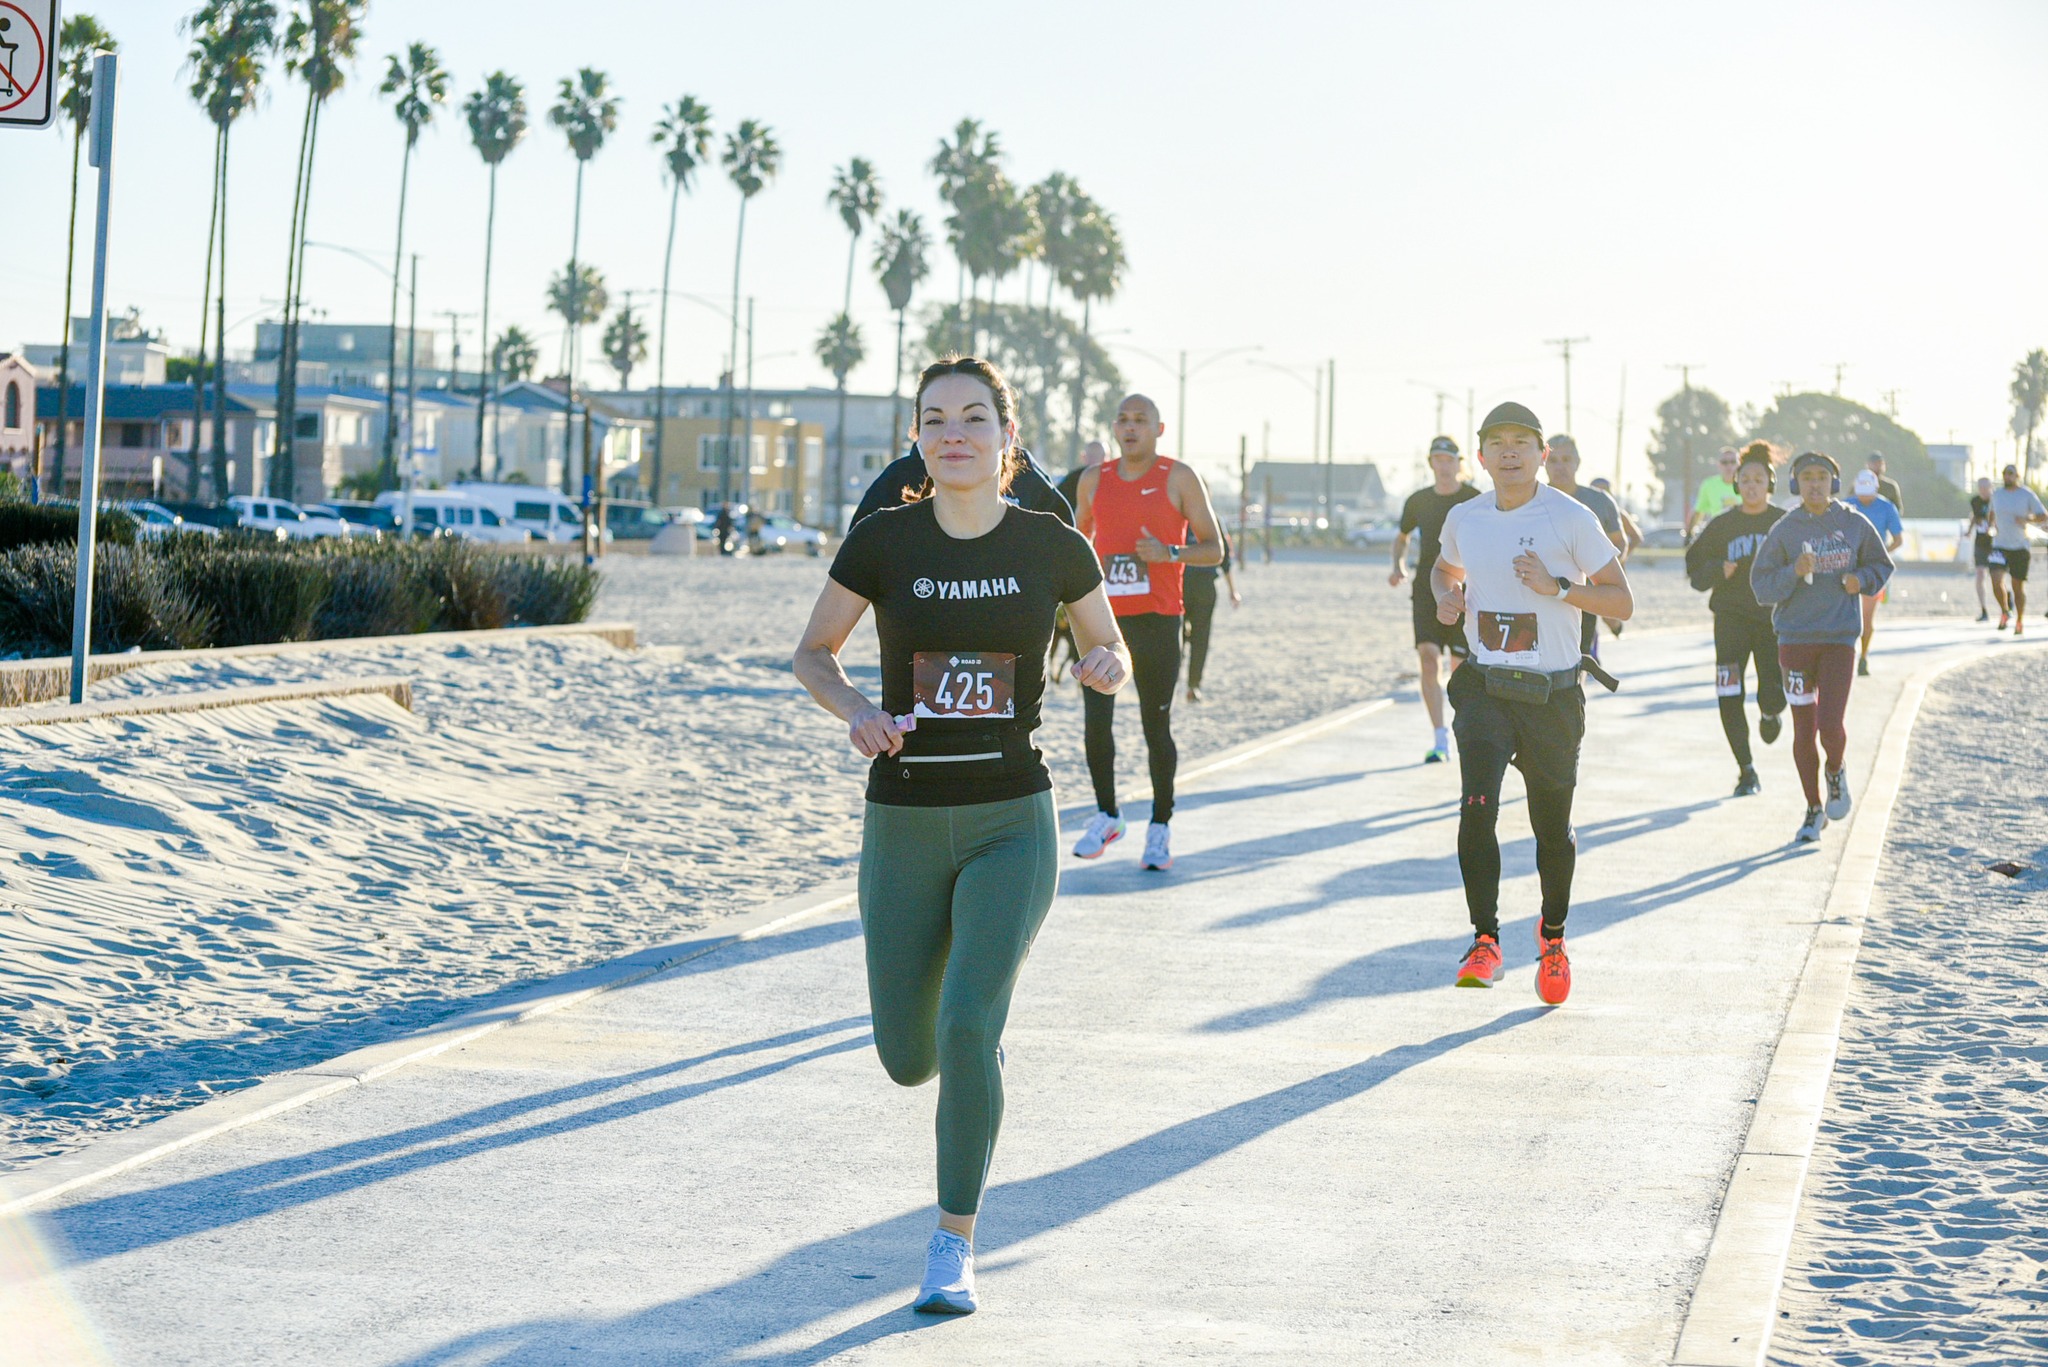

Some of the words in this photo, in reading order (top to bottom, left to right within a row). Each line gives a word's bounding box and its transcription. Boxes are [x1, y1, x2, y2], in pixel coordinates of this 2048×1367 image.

[1109, 562, 1138, 583] 443
[937, 576, 1021, 600] YAMAHA
[1499, 624, 1510, 649] 7
[935, 671, 994, 710] 425
[1788, 676, 1804, 695] 73
